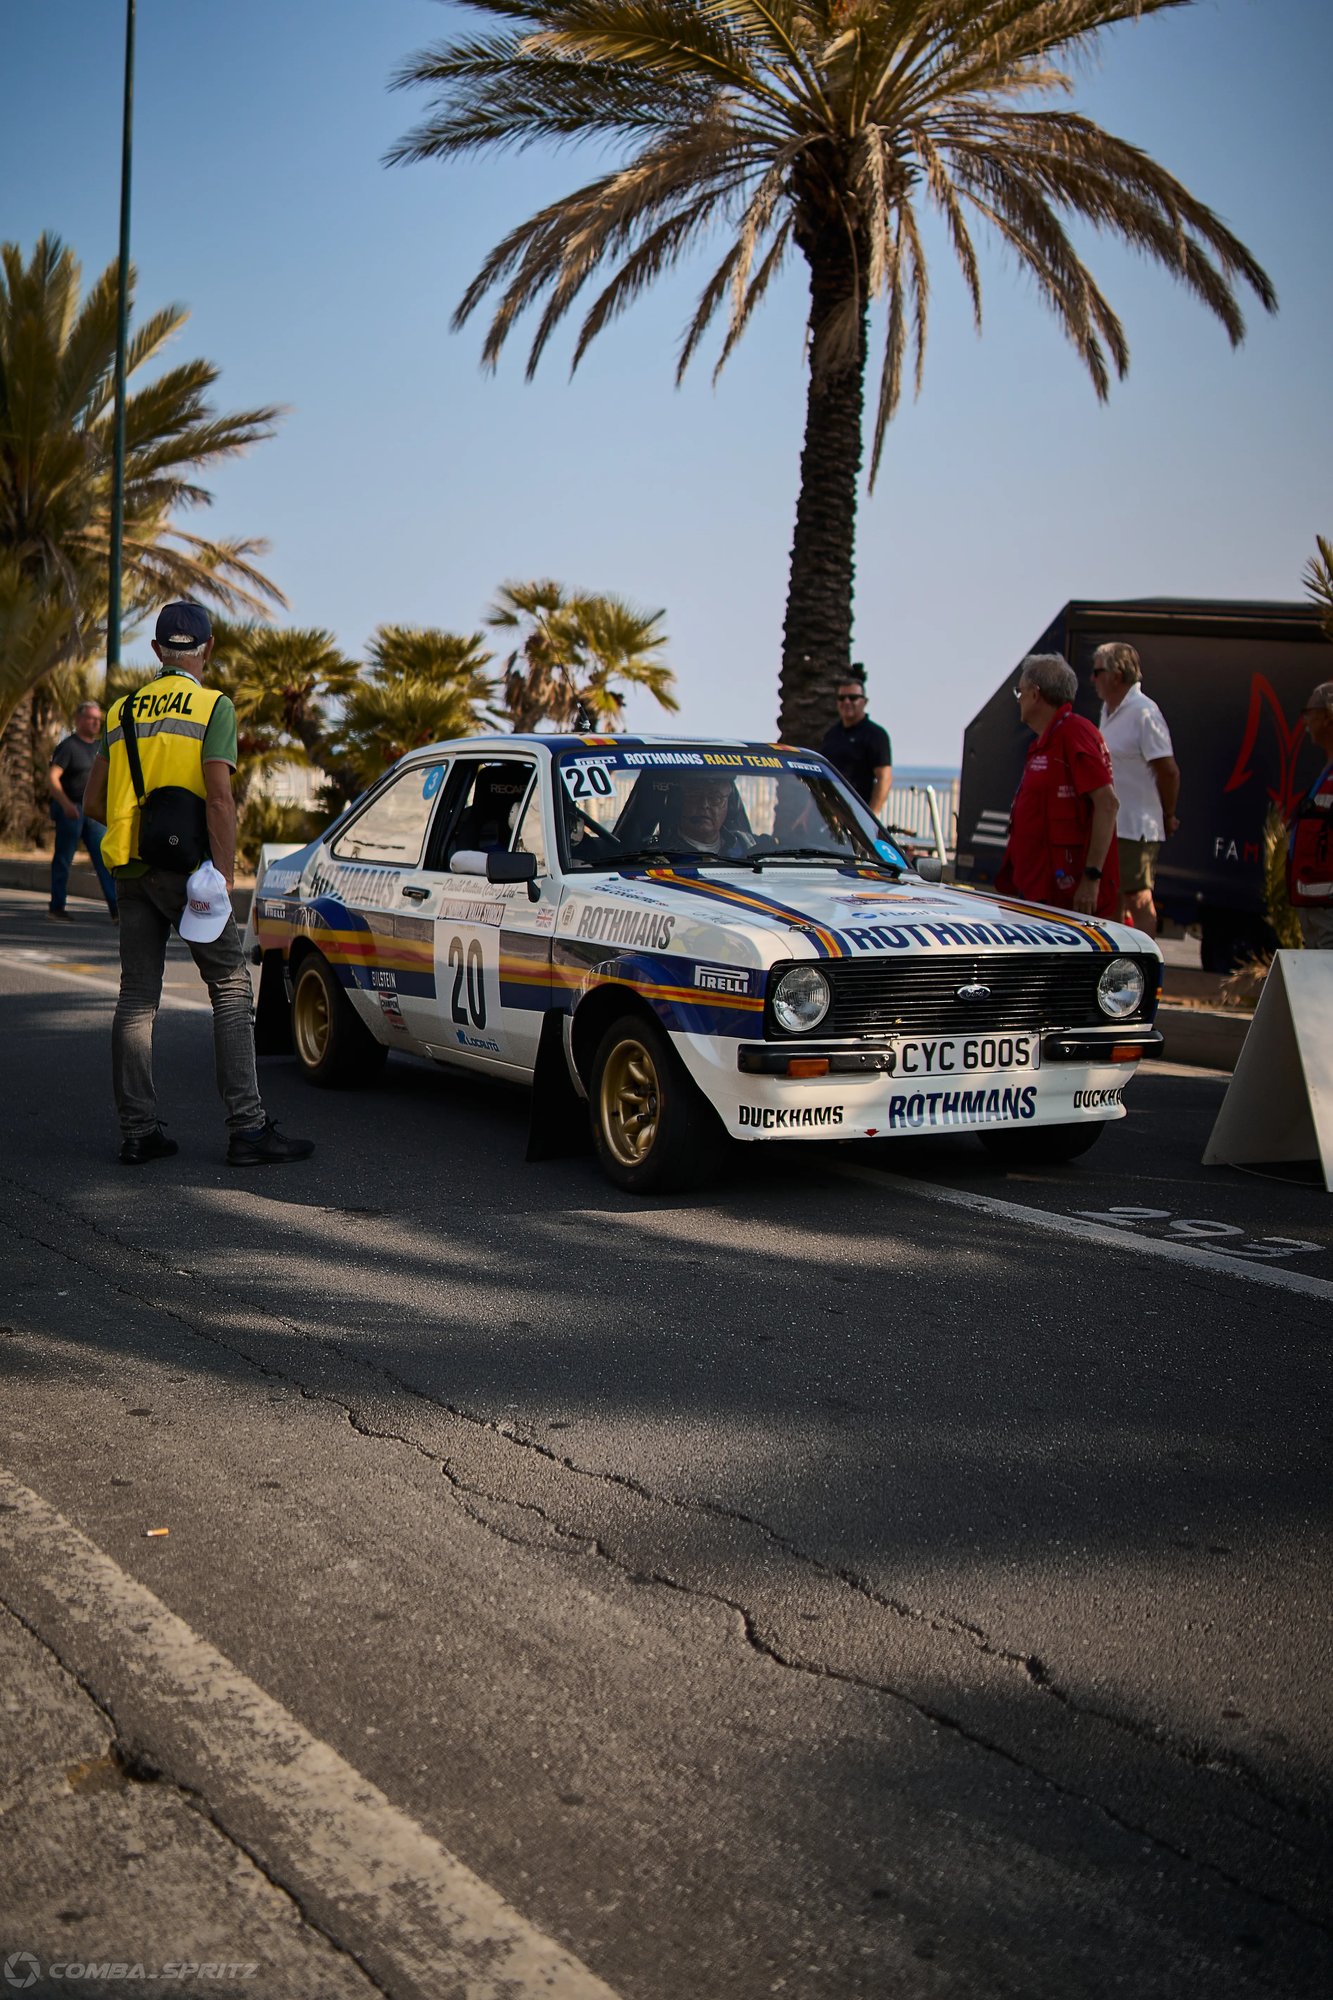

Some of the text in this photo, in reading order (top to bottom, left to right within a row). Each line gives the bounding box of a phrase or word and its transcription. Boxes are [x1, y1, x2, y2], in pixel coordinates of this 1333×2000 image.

[623, 753, 783, 769] ROTHMANS RALLY TEAM
[428, 771, 439, 790] 3
[565, 766, 612, 798] 20
[881, 845, 897, 861] 3
[264, 902, 286, 919] PIRELLI
[576, 905, 675, 950] ROTHMANS
[838, 922, 1082, 951] ROTHMANS
[447, 936, 487, 1030] 20
[694, 965, 749, 993] PIRELLI
[902, 1037, 1030, 1073] CYC 600S
[738, 1105, 844, 1128] DUCKHAMS
[889, 1086, 1037, 1129] ROTHMANS
